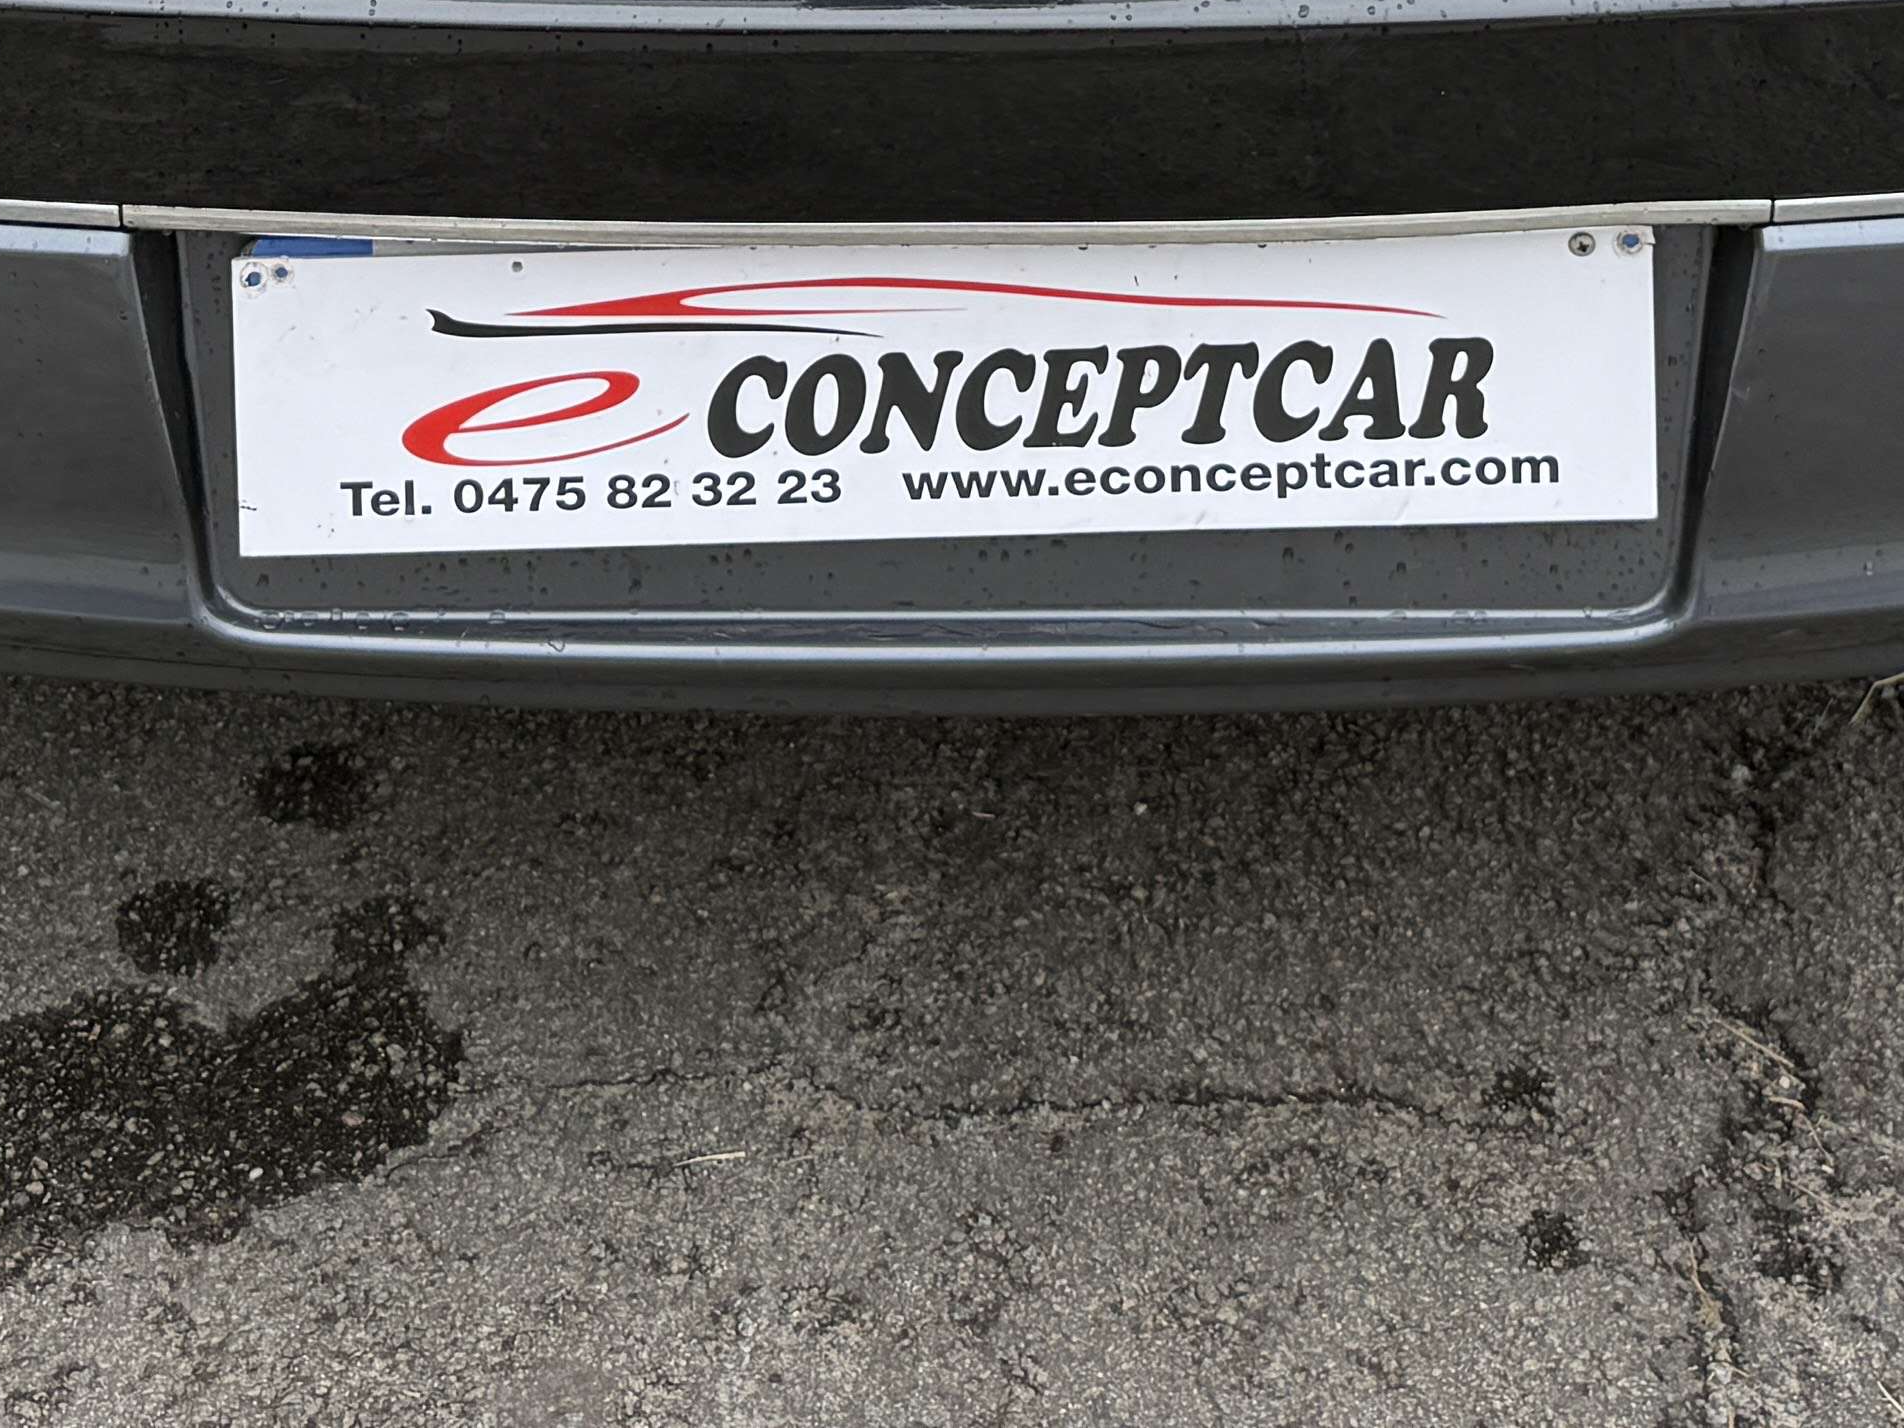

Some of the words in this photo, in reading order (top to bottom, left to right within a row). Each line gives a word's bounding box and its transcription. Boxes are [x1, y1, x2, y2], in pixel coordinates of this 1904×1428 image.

[707, 337, 1494, 459] CONCEPTCAR
[340, 480, 432, 516] Tel.
[453, 476, 586, 514] 0475
[607, 473, 673, 509] 82
[692, 471, 757, 507] 32
[777, 468, 842, 505] 23
[902, 453, 1559, 501] www.econceptcar.com
